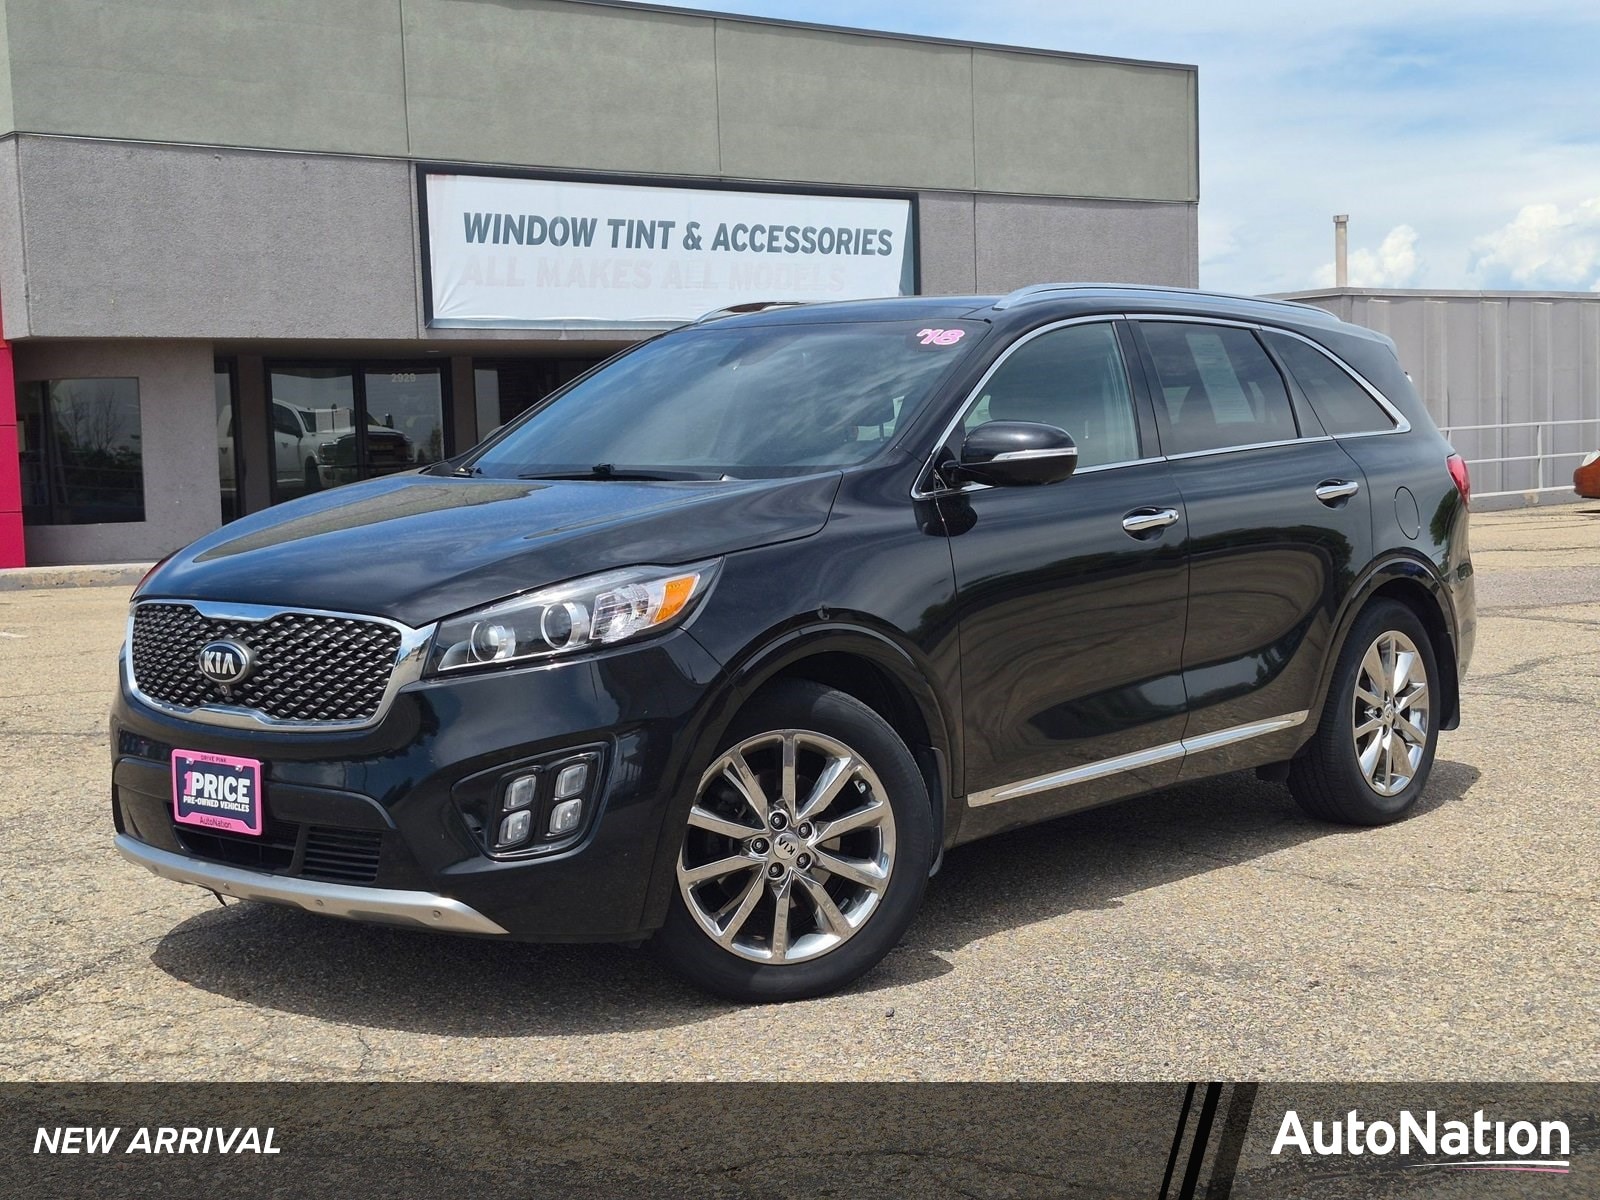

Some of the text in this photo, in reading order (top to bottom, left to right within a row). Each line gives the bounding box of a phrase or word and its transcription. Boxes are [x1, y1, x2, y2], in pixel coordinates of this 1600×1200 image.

[464, 212, 893, 256] WINDOW TINT & ACCESSORIES
[461, 254, 526, 286] ALL
[536, 255, 653, 289] MAKES
[661, 257, 718, 289] ALL
[203, 650, 237, 675] KIA
[183, 795, 249, 812] PRE-OWNED VEHICLES
[200, 816, 232, 828] AutoNation
[778, 838, 796, 855] KIA
